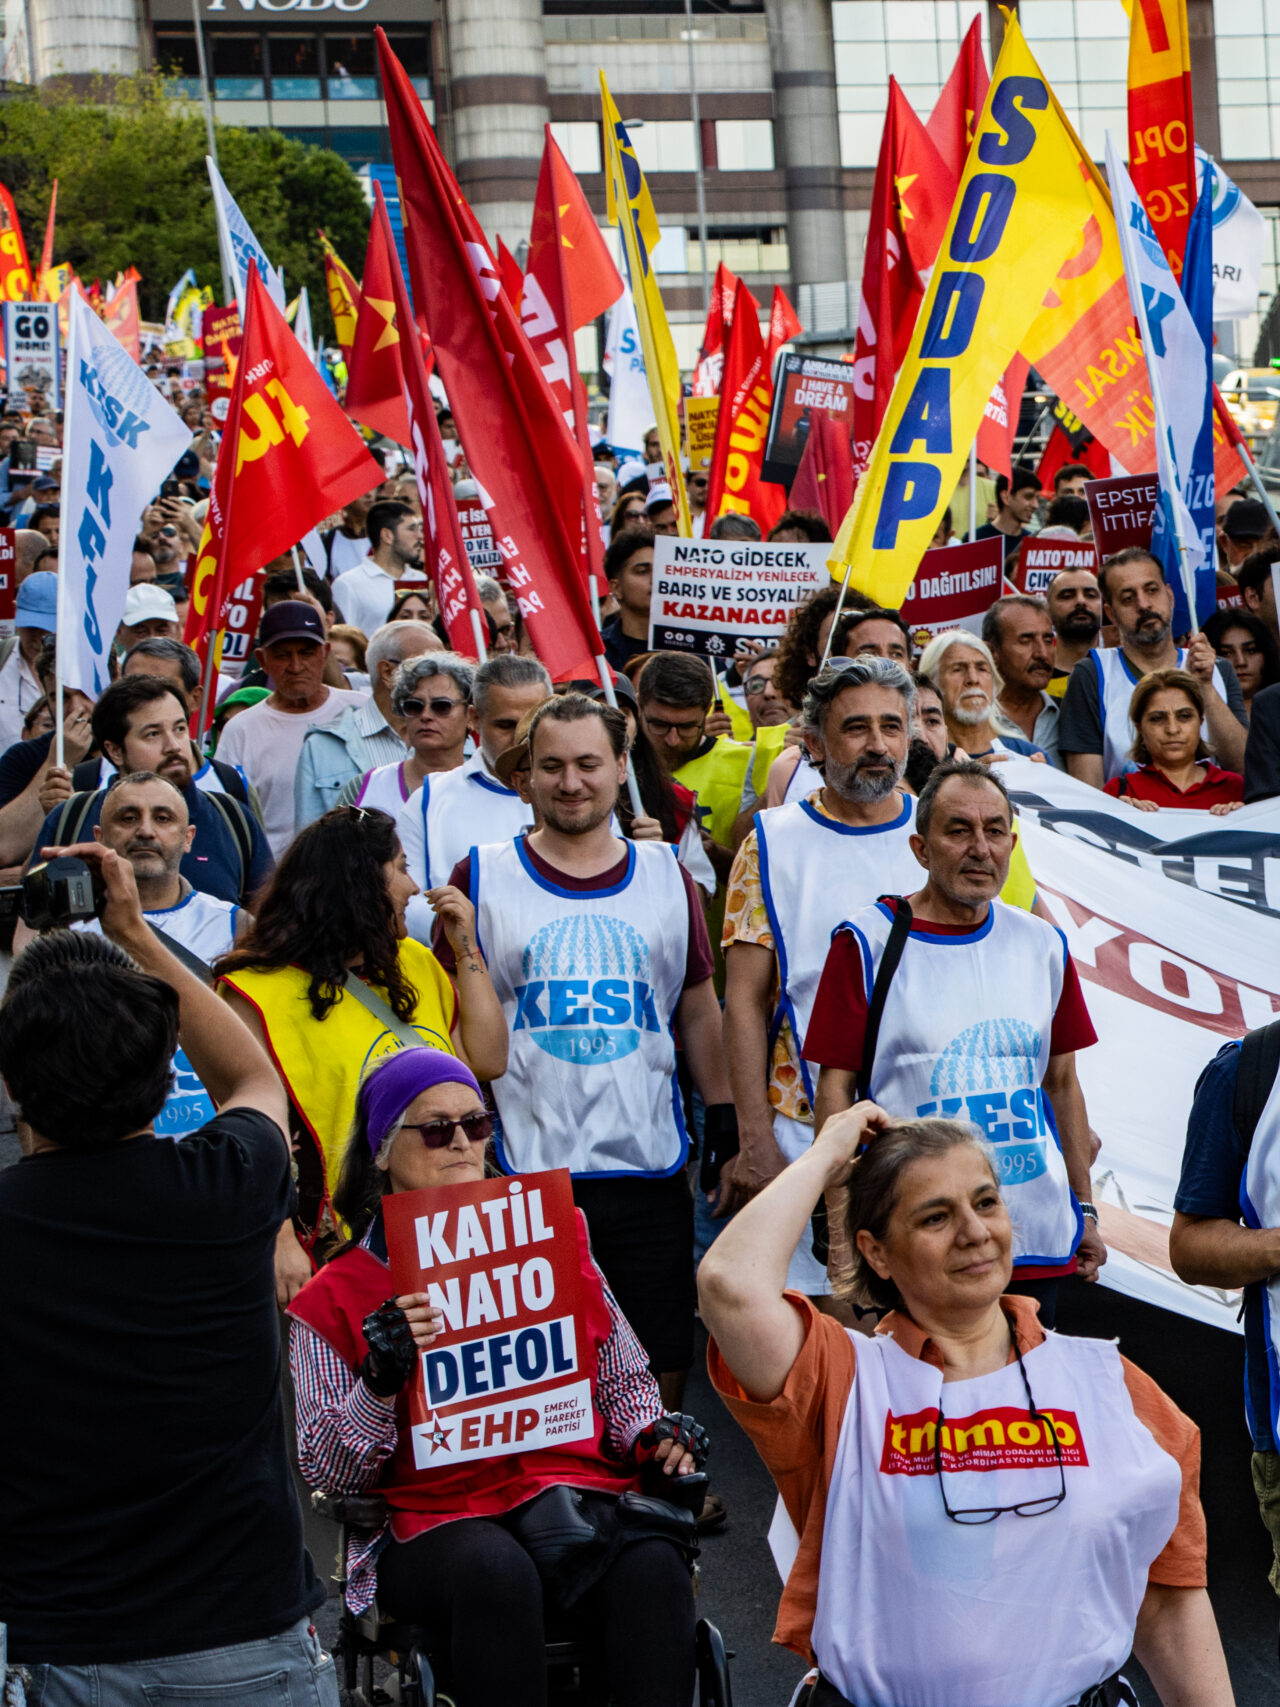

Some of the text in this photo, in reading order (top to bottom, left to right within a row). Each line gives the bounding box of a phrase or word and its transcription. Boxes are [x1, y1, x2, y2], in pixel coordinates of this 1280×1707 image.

[873, 75, 1049, 550] SODAP
[15, 315, 49, 339] GO
[801, 378, 845, 395] I HAVE A
[794, 389, 849, 412] DREAM
[674, 546, 811, 569] NATO GİDECEK,
[1026, 549, 1094, 567] NATO'DAN
[664, 564, 753, 582] EMPERYALİZM
[920, 565, 998, 599] DAĞITILSIN!
[657, 580, 707, 600] BARIŞ
[711, 586, 732, 601] VE
[513, 979, 661, 1033] KESK
[570, 1036, 617, 1057] 1995
[1002, 1151, 1037, 1177] 995
[414, 1181, 555, 1270] KATİL
[427, 1256, 555, 1335] NATO
[425, 1320, 574, 1405] DEFOL
[544, 1396, 579, 1414] EMEKÇİ
[545, 1408, 587, 1426] HAREKET
[460, 1407, 540, 1452] EHP
[545, 1421, 581, 1437] PARTİSİ
[890, 1412, 1077, 1456] tmmob
[950, 1456, 1034, 1469] KOORDİNASYON
[972, 1448, 1003, 1457] MİMAR
[1005, 1448, 1044, 1456] ODALARI
